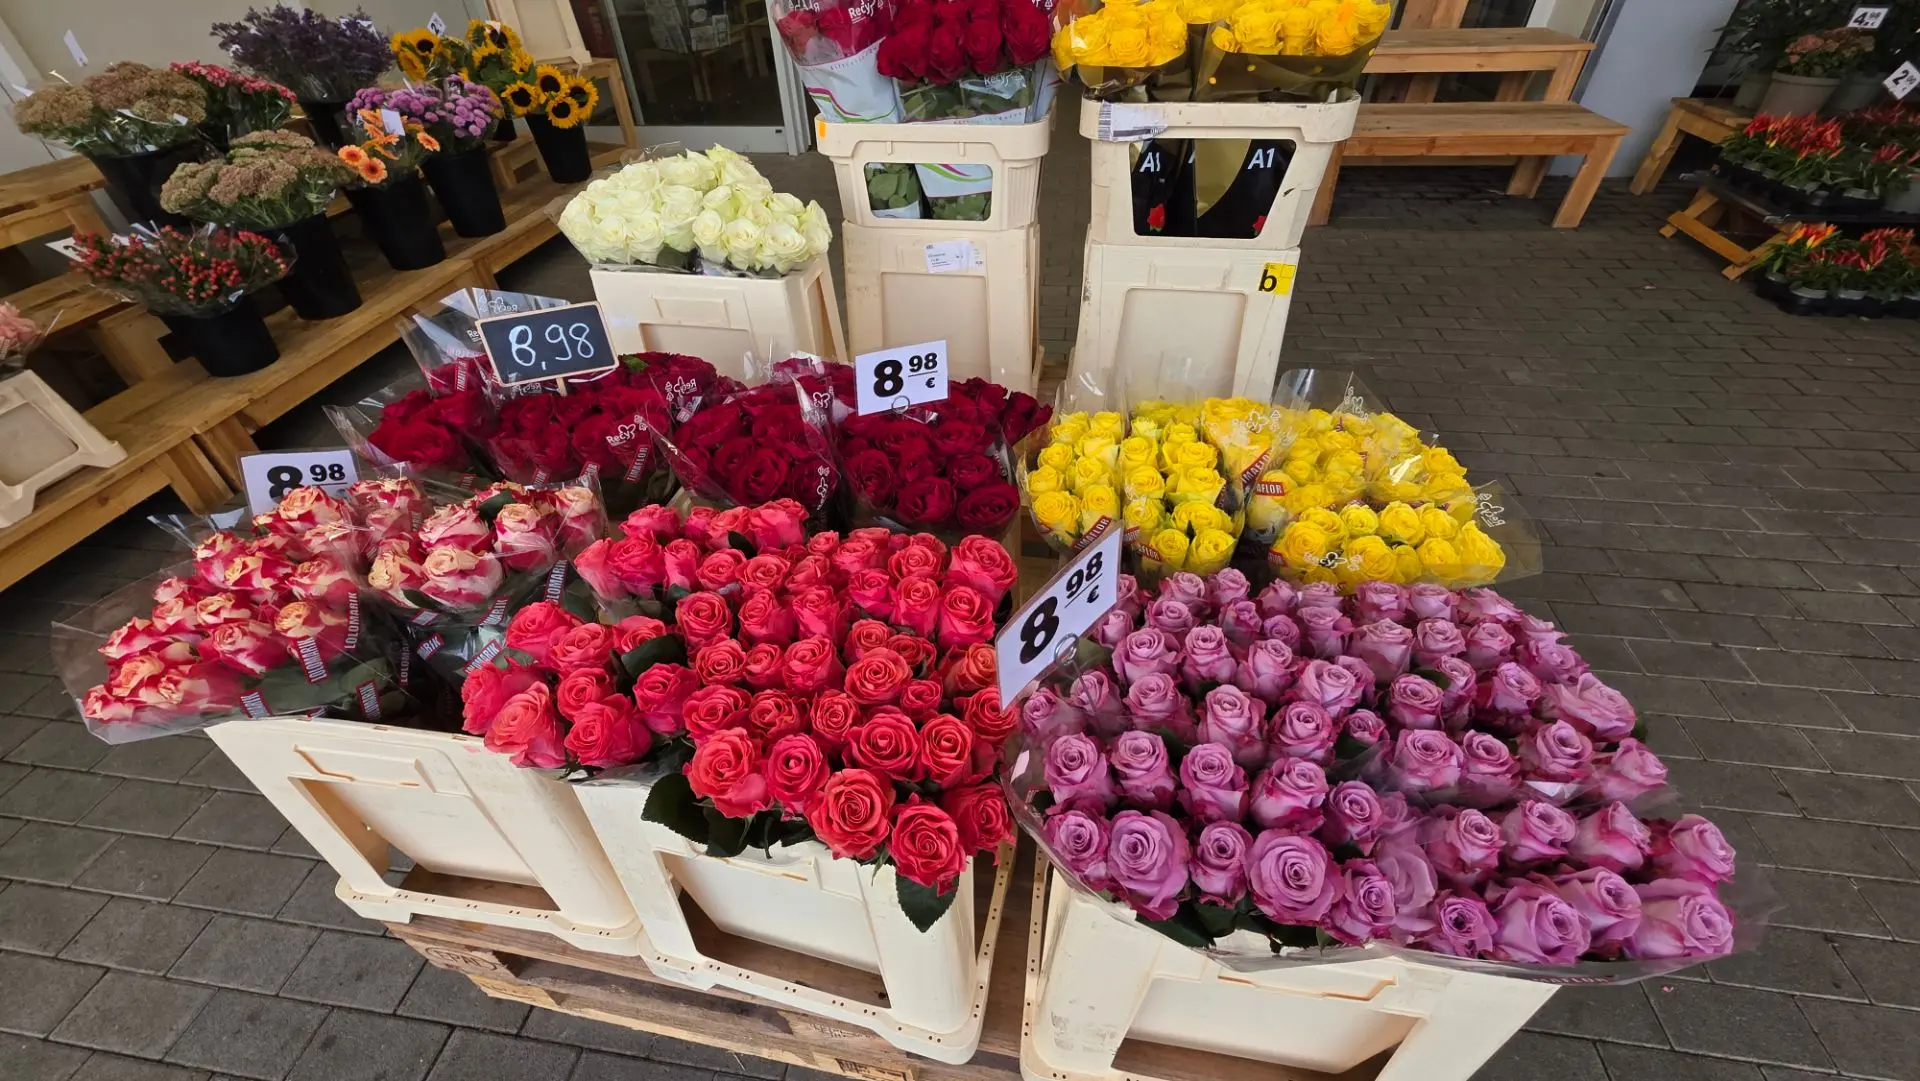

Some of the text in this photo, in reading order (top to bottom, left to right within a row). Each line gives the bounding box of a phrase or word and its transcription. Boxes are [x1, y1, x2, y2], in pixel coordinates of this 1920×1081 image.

[1247, 147, 1275, 169] A1
[1258, 268, 1278, 292] b
[508, 323, 594, 371] 8,98
[873, 352, 938, 398] 8 98 €
[267, 463, 346, 504] 8 98
[344, 591, 361, 649] LOLOMARIK
[1019, 551, 1104, 665] 8 98 €
